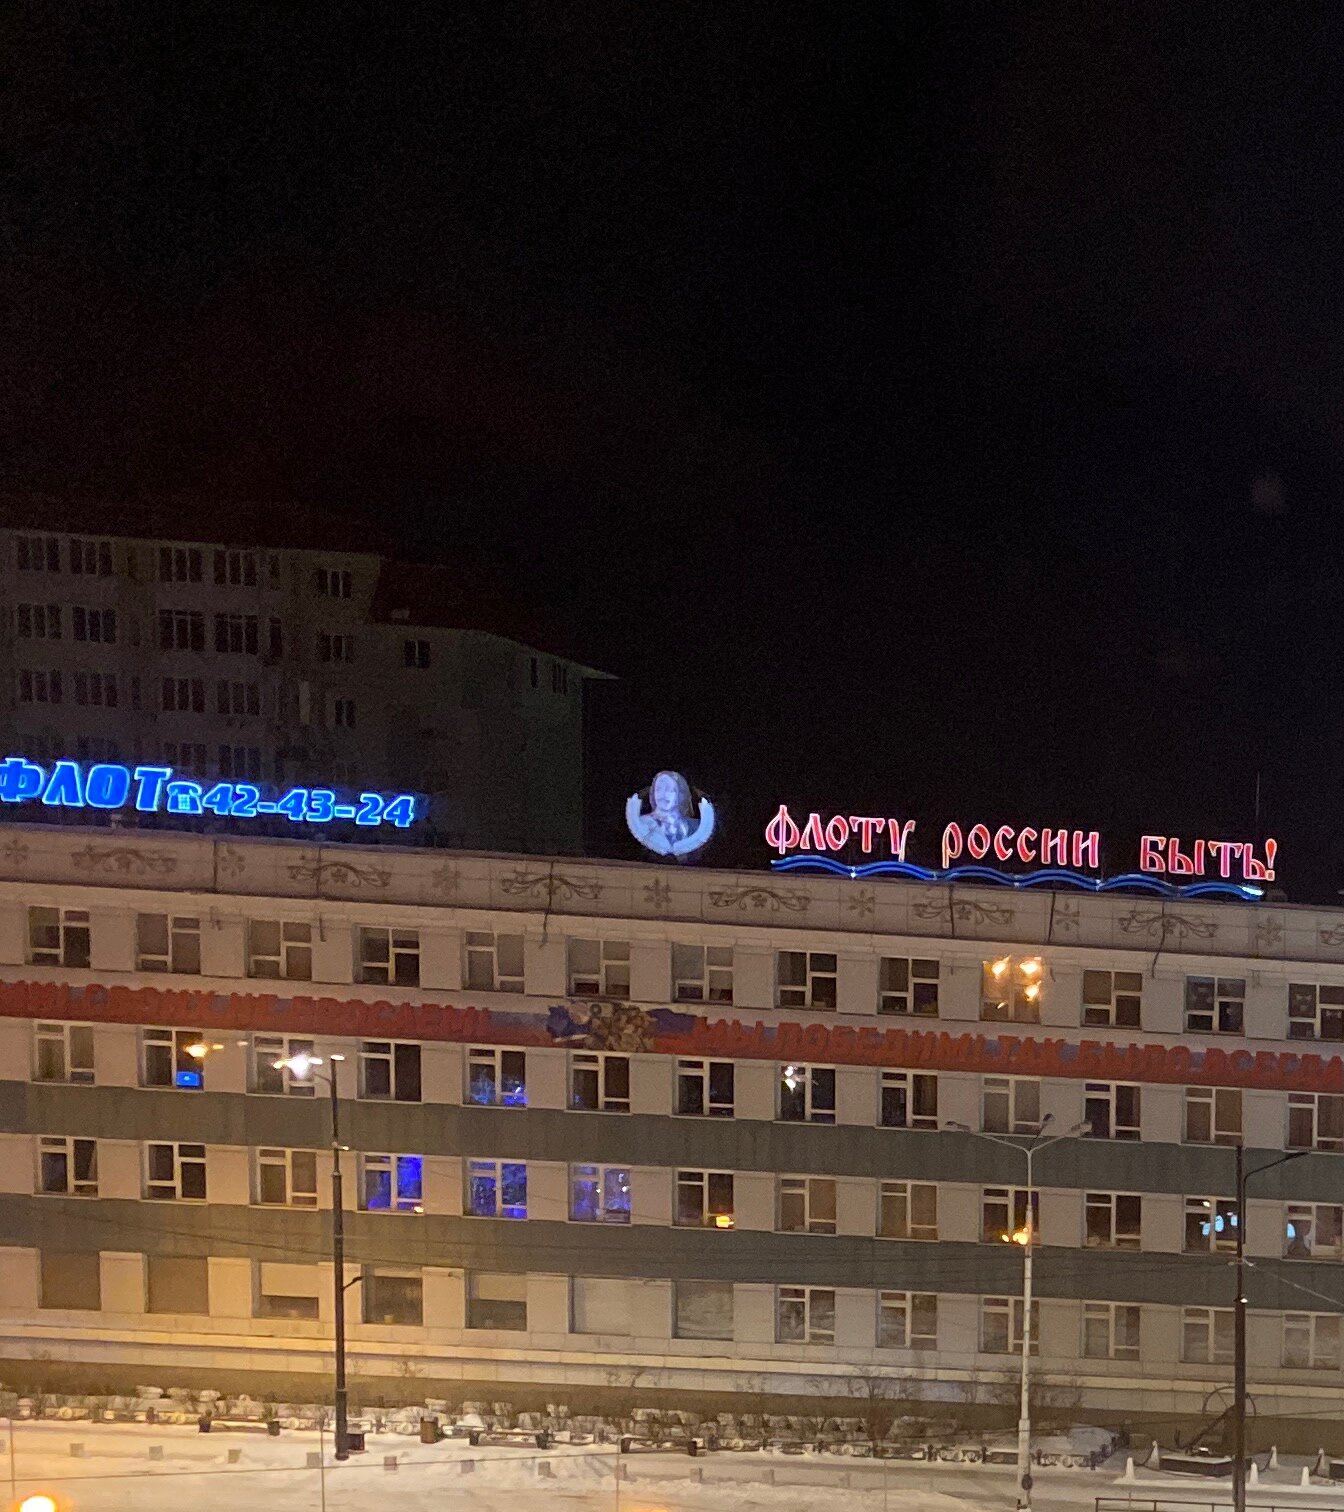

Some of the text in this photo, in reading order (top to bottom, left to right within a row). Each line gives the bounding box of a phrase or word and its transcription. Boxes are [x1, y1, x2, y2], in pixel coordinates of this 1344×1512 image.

[0, 757, 415, 828] ФЛОТ 42-43-24
[1140, 835, 1277, 881] БЫТЬ!
